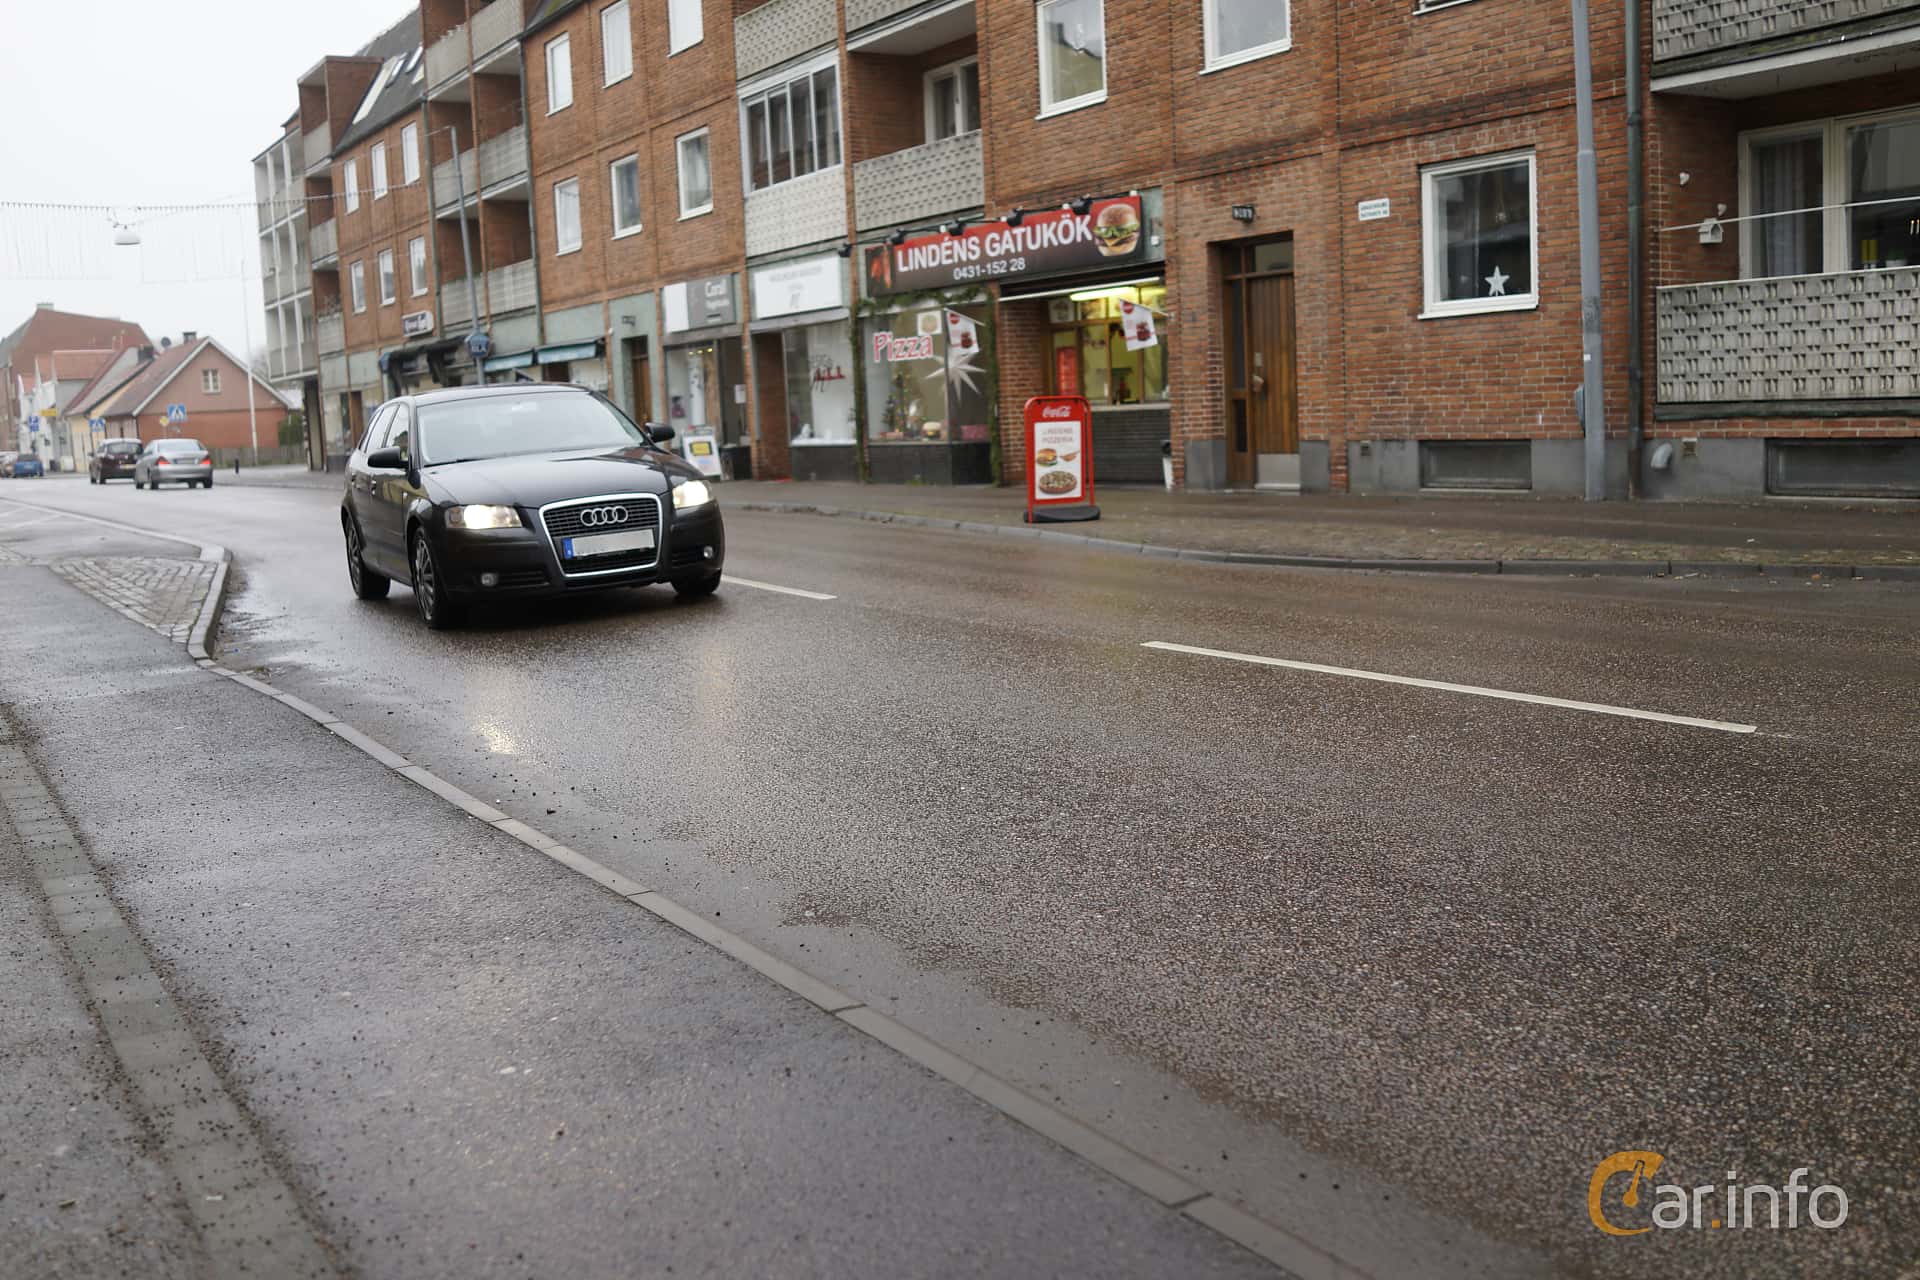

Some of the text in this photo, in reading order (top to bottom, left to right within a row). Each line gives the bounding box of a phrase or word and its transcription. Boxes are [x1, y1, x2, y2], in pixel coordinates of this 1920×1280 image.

[897, 214, 1093, 272] LINDÉNS GATUKÖK
[953, 257, 1026, 280] 0431-152 28
[873, 331, 933, 362] Pizza
